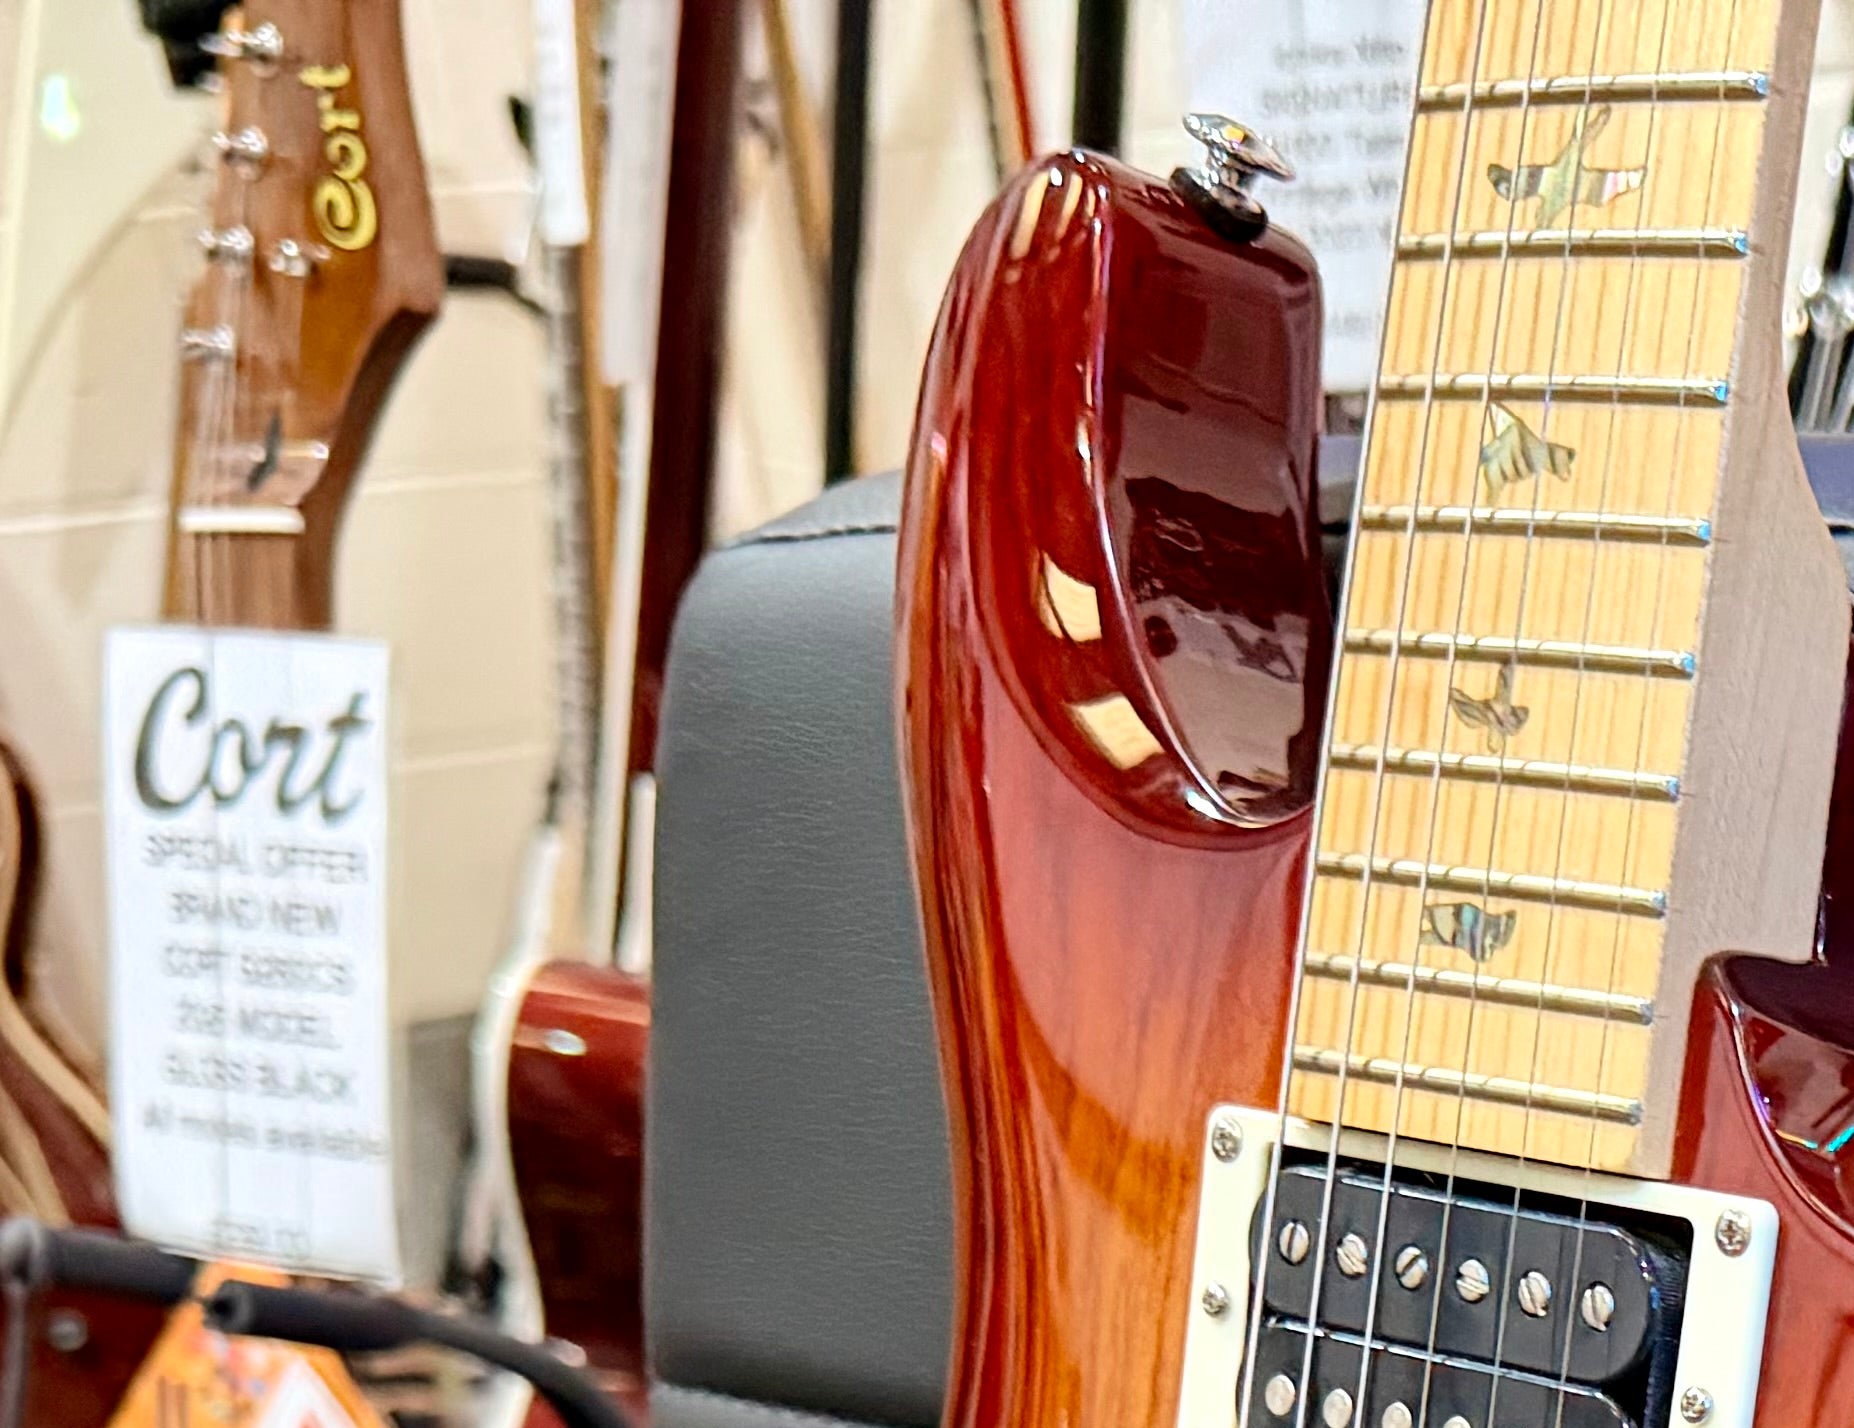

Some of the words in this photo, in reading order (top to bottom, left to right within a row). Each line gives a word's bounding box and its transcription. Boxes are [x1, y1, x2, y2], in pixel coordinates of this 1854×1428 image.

[298, 63, 377, 250] Cort
[134, 667, 371, 827] Cort
[261, 842, 368, 884] OFFER
[269, 899, 341, 937] NEW
